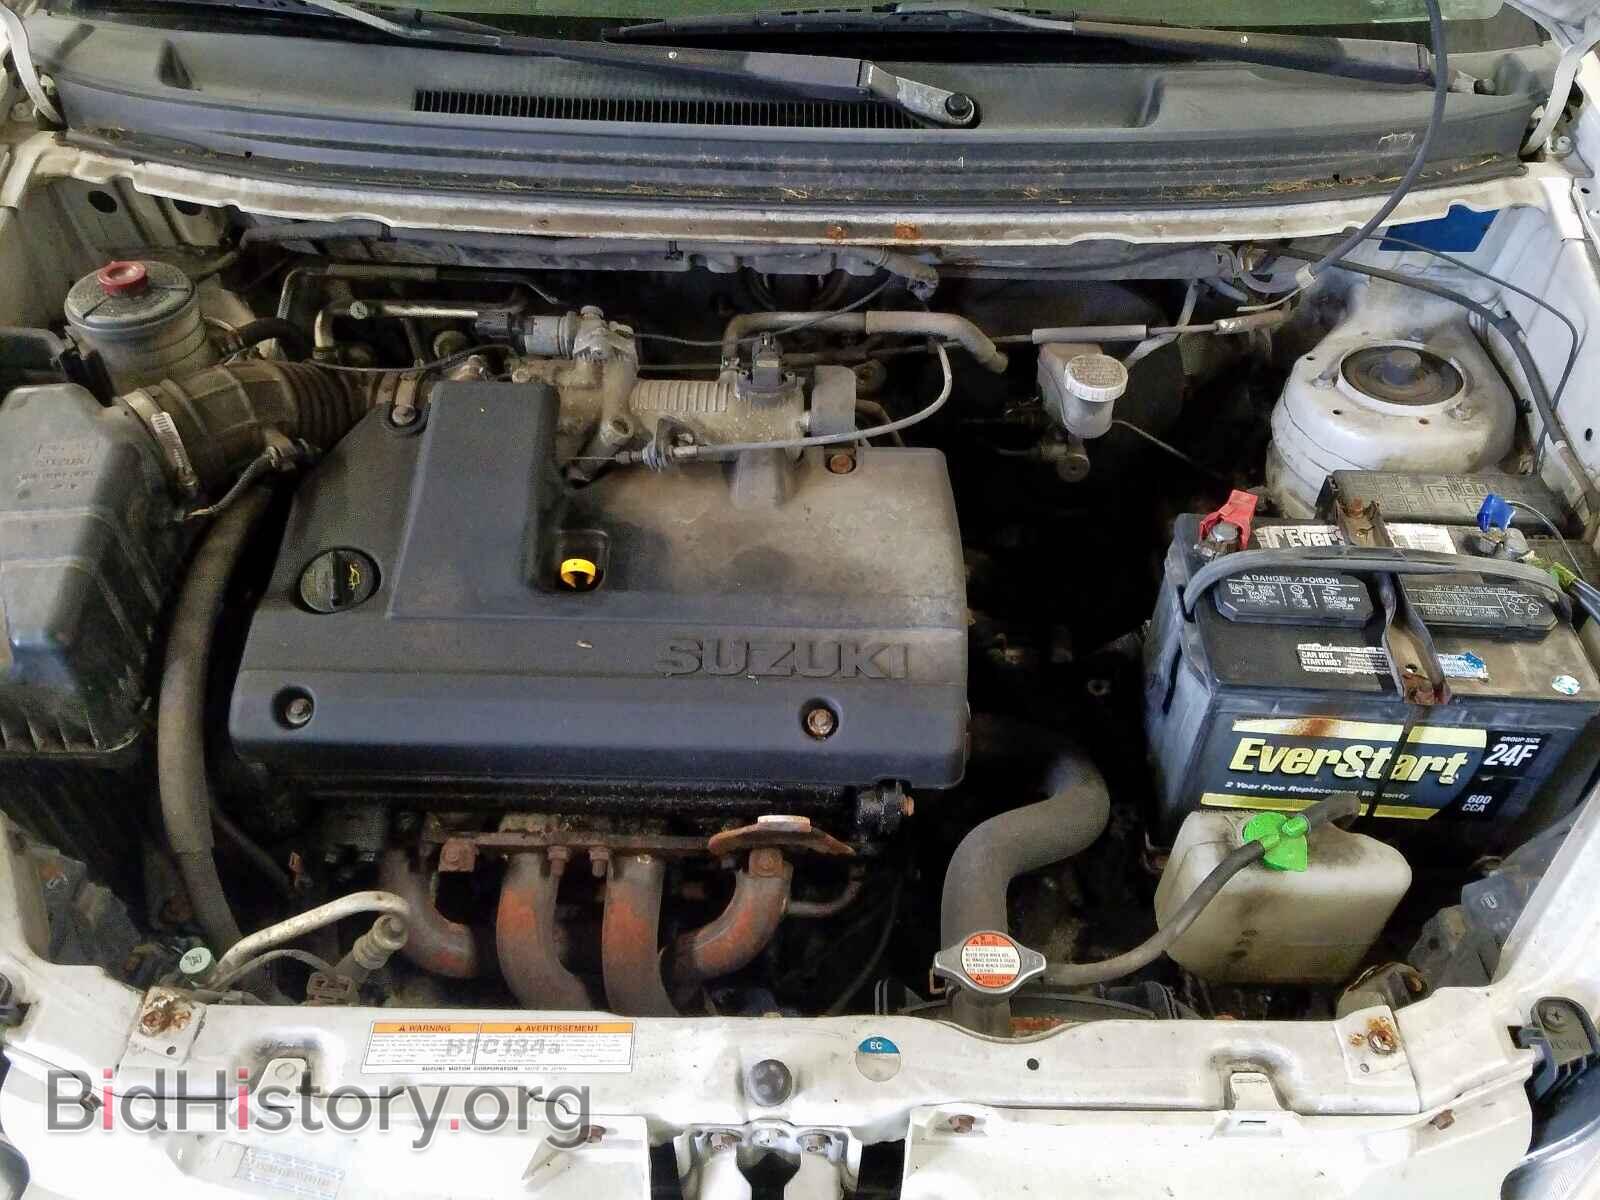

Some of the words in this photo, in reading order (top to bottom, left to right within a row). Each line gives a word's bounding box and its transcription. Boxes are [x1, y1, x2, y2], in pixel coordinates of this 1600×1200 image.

[1251, 574, 1292, 584] DANGER
[1301, 576, 1339, 585] POISON
[655, 638, 910, 679] SUZUKI
[1318, 651, 1334, 659] NOT
[1483, 743, 1540, 767] 24F
[1229, 737, 1468, 785] EverStart
[1236, 782, 1258, 790] Year
[1260, 783, 1285, 792] Free
[1467, 794, 1492, 804] 600
[1462, 803, 1486, 813] CCA
[408, 1024, 451, 1032] WARNING
[525, 1024, 599, 1032] AVERTISSEMENT
[870, 1041, 882, 1050] EC
